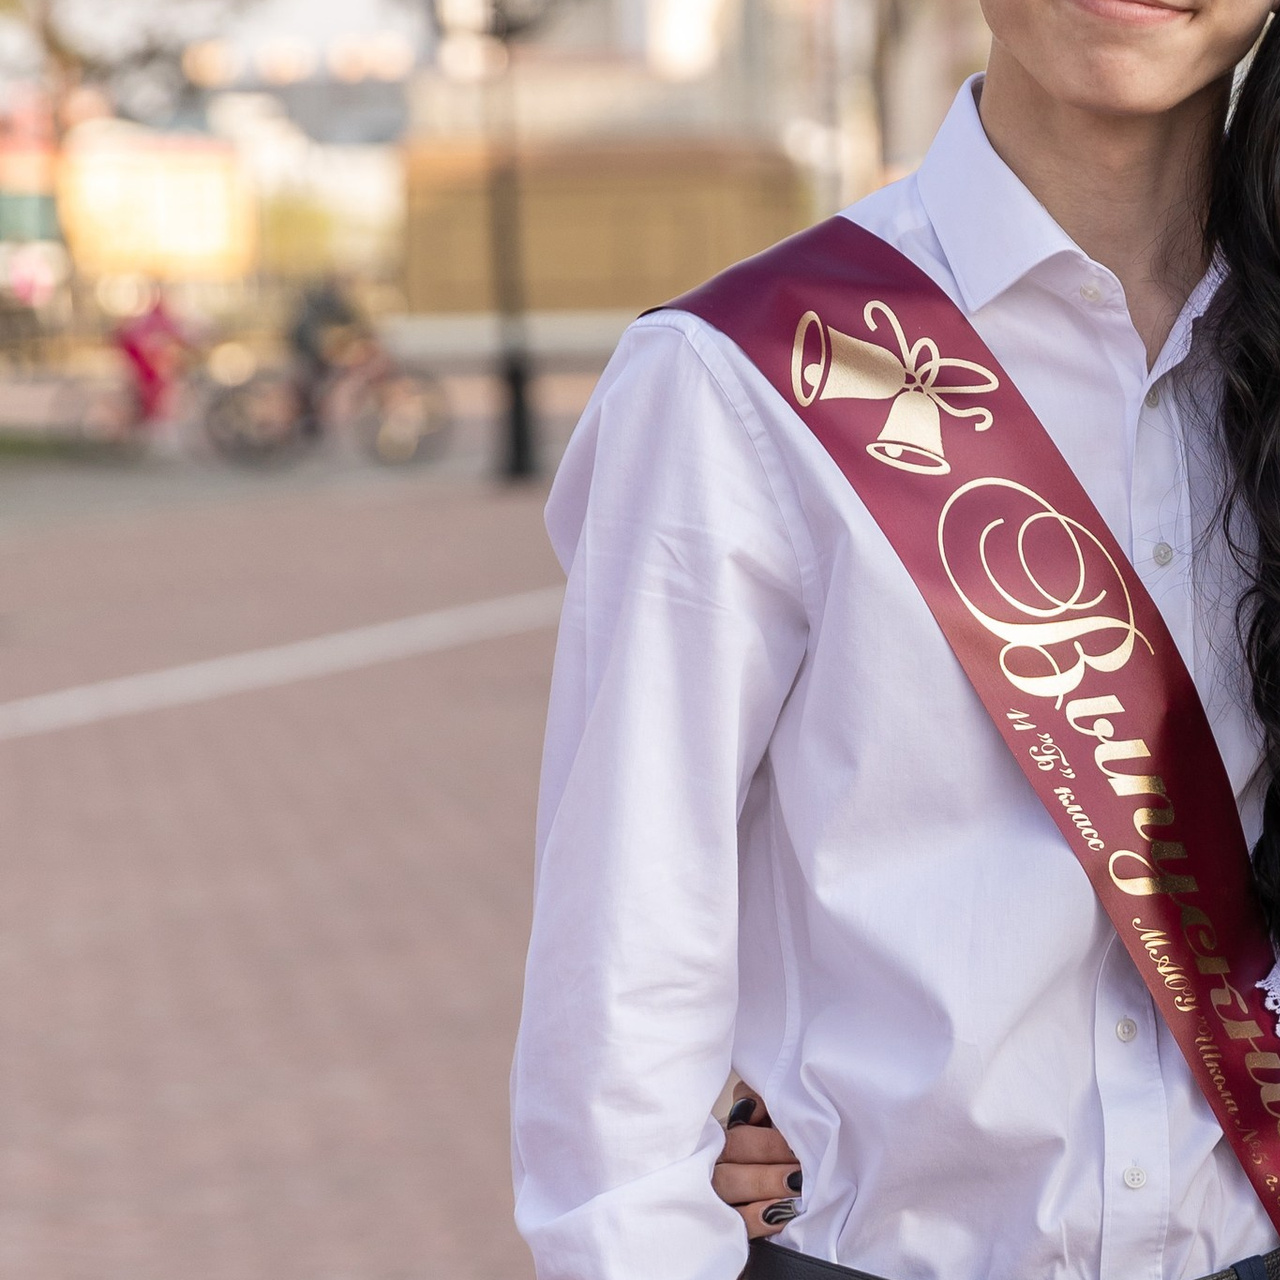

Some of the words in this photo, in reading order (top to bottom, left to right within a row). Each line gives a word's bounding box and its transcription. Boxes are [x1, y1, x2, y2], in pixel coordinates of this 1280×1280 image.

[1006, 707, 1038, 732] 11
[1053, 785, 1105, 853] класс
[1131, 916, 1199, 1014] МАОУ
